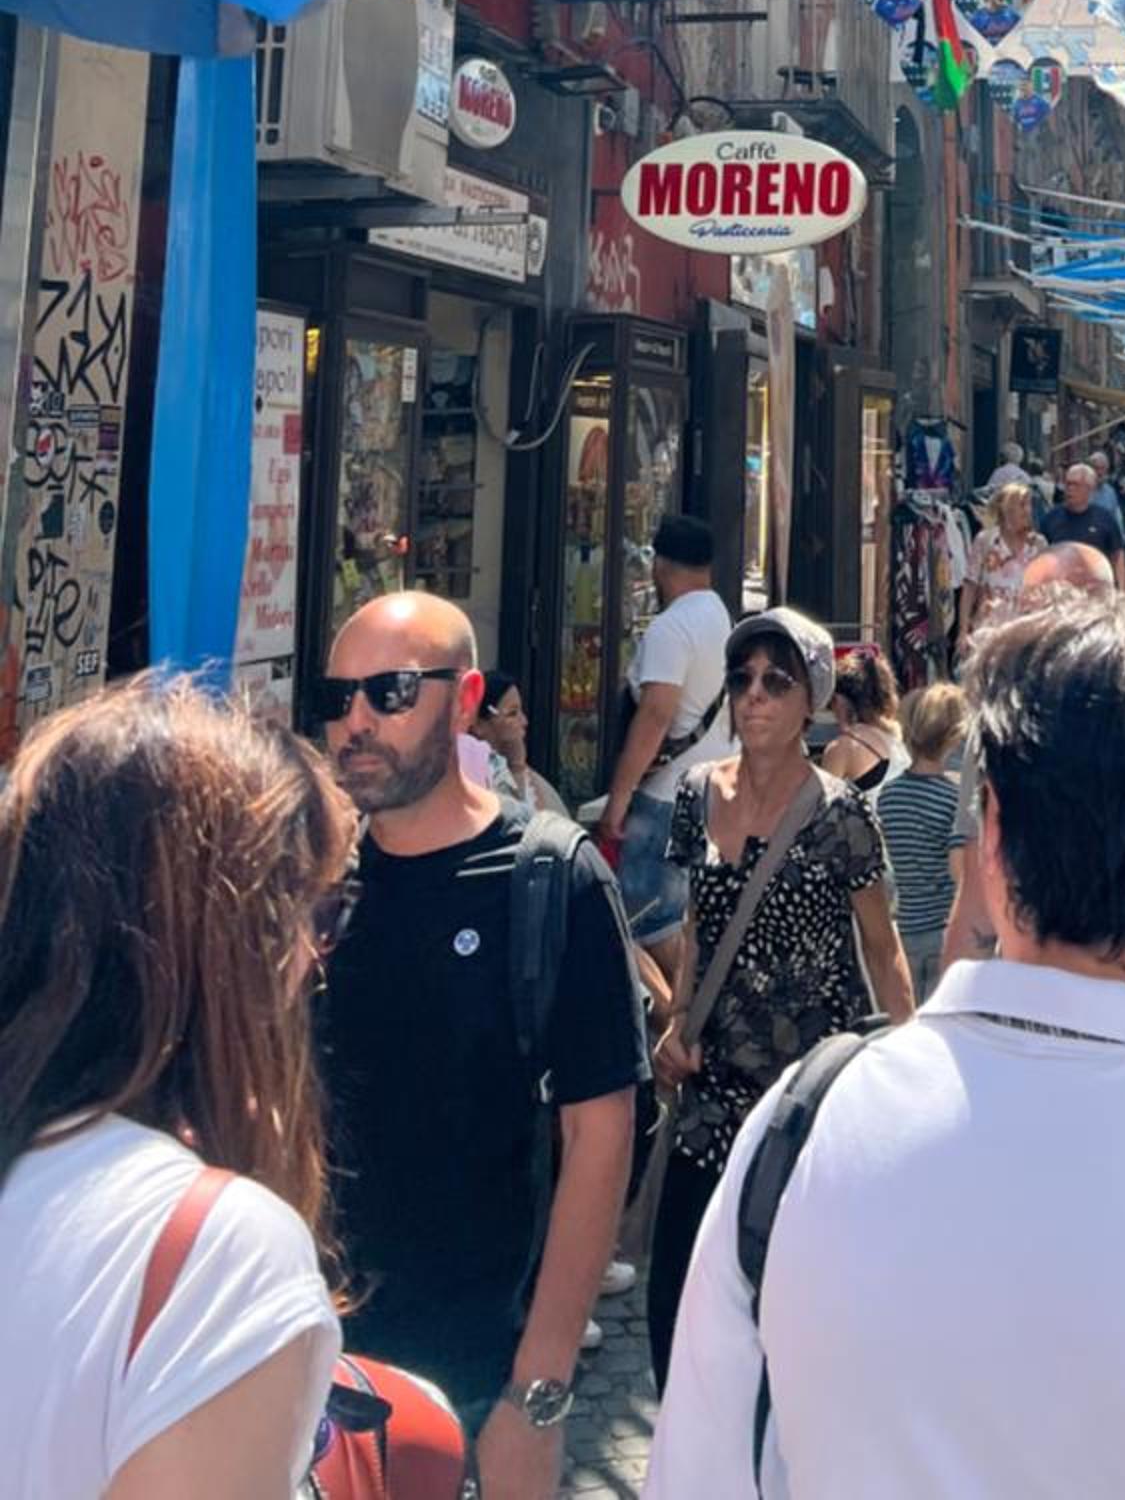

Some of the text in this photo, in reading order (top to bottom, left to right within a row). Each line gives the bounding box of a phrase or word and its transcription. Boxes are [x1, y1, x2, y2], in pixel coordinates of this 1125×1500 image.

[716, 141, 778, 161] Caffè
[638, 160, 852, 217] MORENO
[256, 316, 293, 352] pori
[255, 355, 297, 395] apoli
